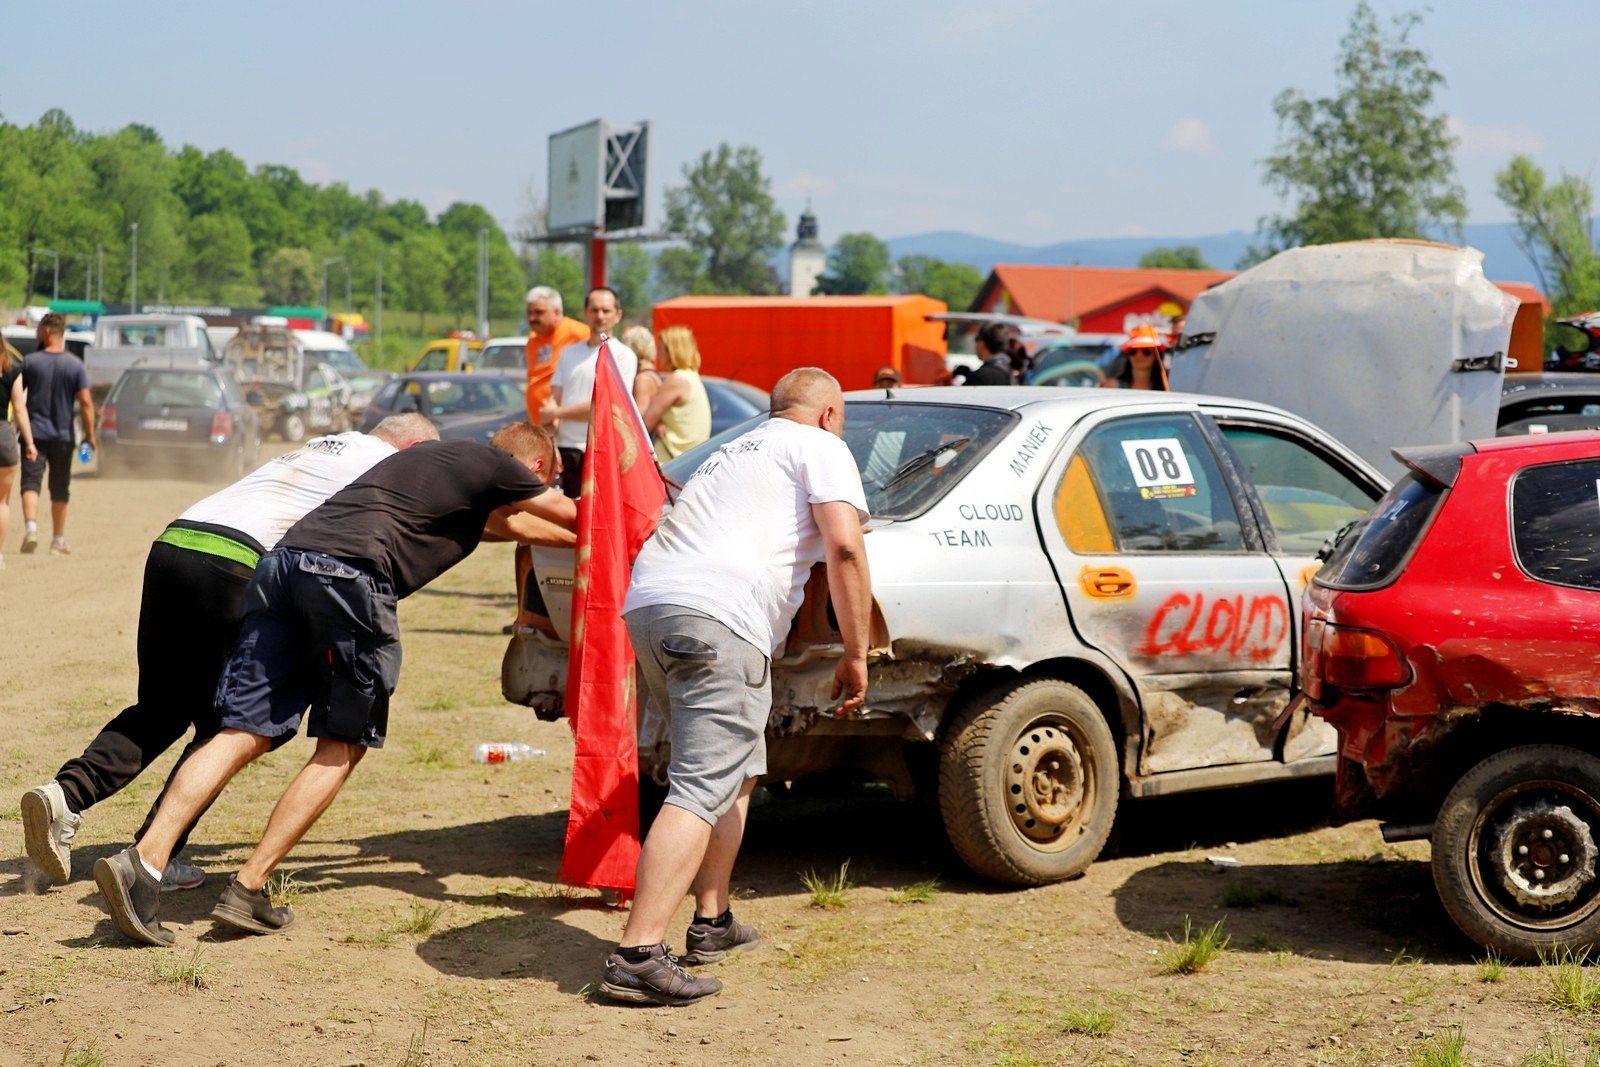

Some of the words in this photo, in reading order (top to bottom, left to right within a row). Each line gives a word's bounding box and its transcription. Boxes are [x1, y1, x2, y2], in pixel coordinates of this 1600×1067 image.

[1009, 420, 1053, 478] MANIEK
[1135, 446, 1181, 481] 08
[959, 504, 1024, 521] CLOUD
[929, 529, 992, 547] TEAM
